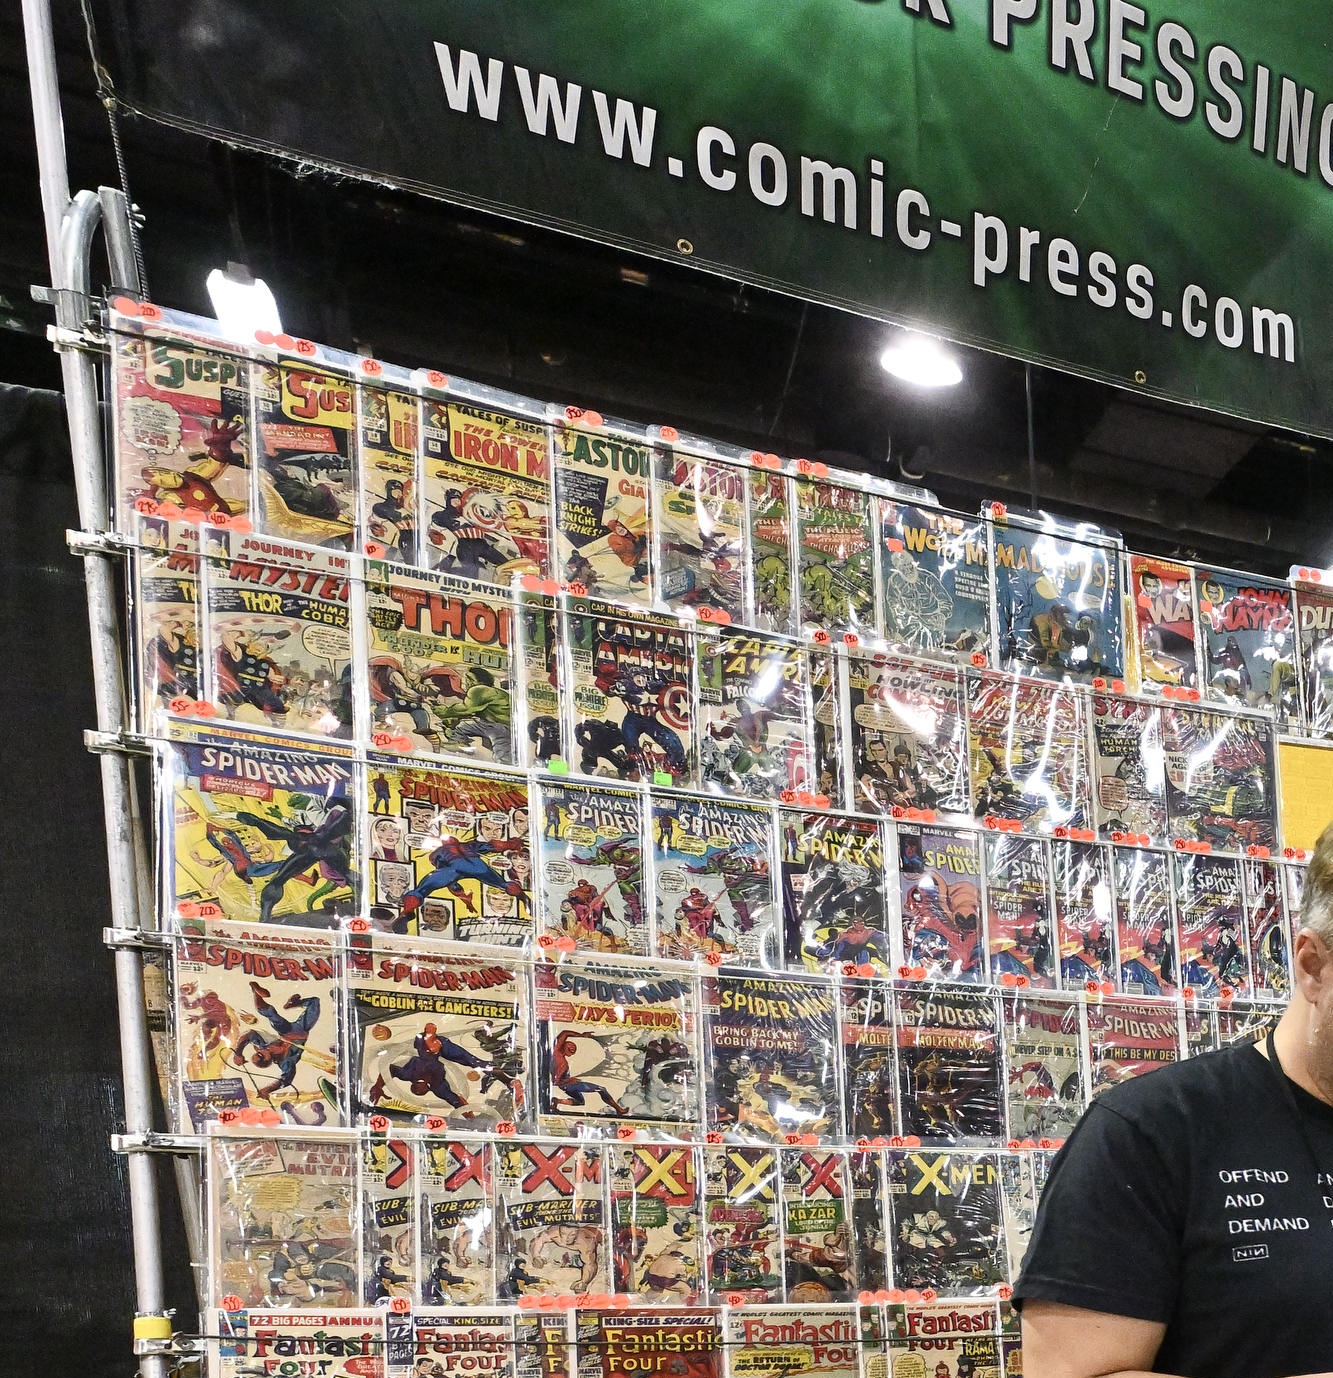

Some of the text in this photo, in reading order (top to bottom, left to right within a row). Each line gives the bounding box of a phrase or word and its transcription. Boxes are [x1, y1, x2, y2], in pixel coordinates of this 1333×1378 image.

[433, 41, 1297, 365] www.comic-press.com
[454, 431, 519, 471] IRON
[561, 502, 595, 517] BLACK
[559, 511, 597, 528] KNIGHT
[559, 520, 602, 539] STRIKES!
[241, 539, 316, 561] JOURNEY
[389, 565, 469, 589] JOURNEY INTO
[239, 591, 283, 614] THOR
[644, 611, 679, 626] MAGAZINE
[209, 728, 302, 751] MARVEL COMICS
[199, 747, 351, 792] SPIDER-MAN
[397, 757, 436, 769] MARVEL
[398, 775, 532, 813] SPIDER-MAN
[923, 827, 953, 838] MARVEL
[378, 958, 512, 991] SPIDER-MAN
[558, 973, 691, 1005] SPIDER-MAN
[371, 994, 513, 1019] GOBLIN GANGSTERS!
[720, 990, 833, 1020] SPIDER-MAN
[714, 1026, 748, 1038] BRING
[715, 1036, 756, 1048] GOBLIN
[1108, 1046, 1129, 1059] THIS
[1219, 1168, 1288, 1184] OFFEND
[509, 1199, 597, 1216] SUB-MARINER
[1225, 1193, 1264, 1208] AND
[516, 1216, 541, 1226] EVIL
[1229, 1218, 1309, 1234] DEMAND
[251, 1316, 324, 1326] 72 BIG PAGES
[417, 1316, 450, 1326] SPECIAL
[604, 1316, 713, 1326] KING-SIZE SPECIAL!
[753, 1355, 789, 1364] RETURN
